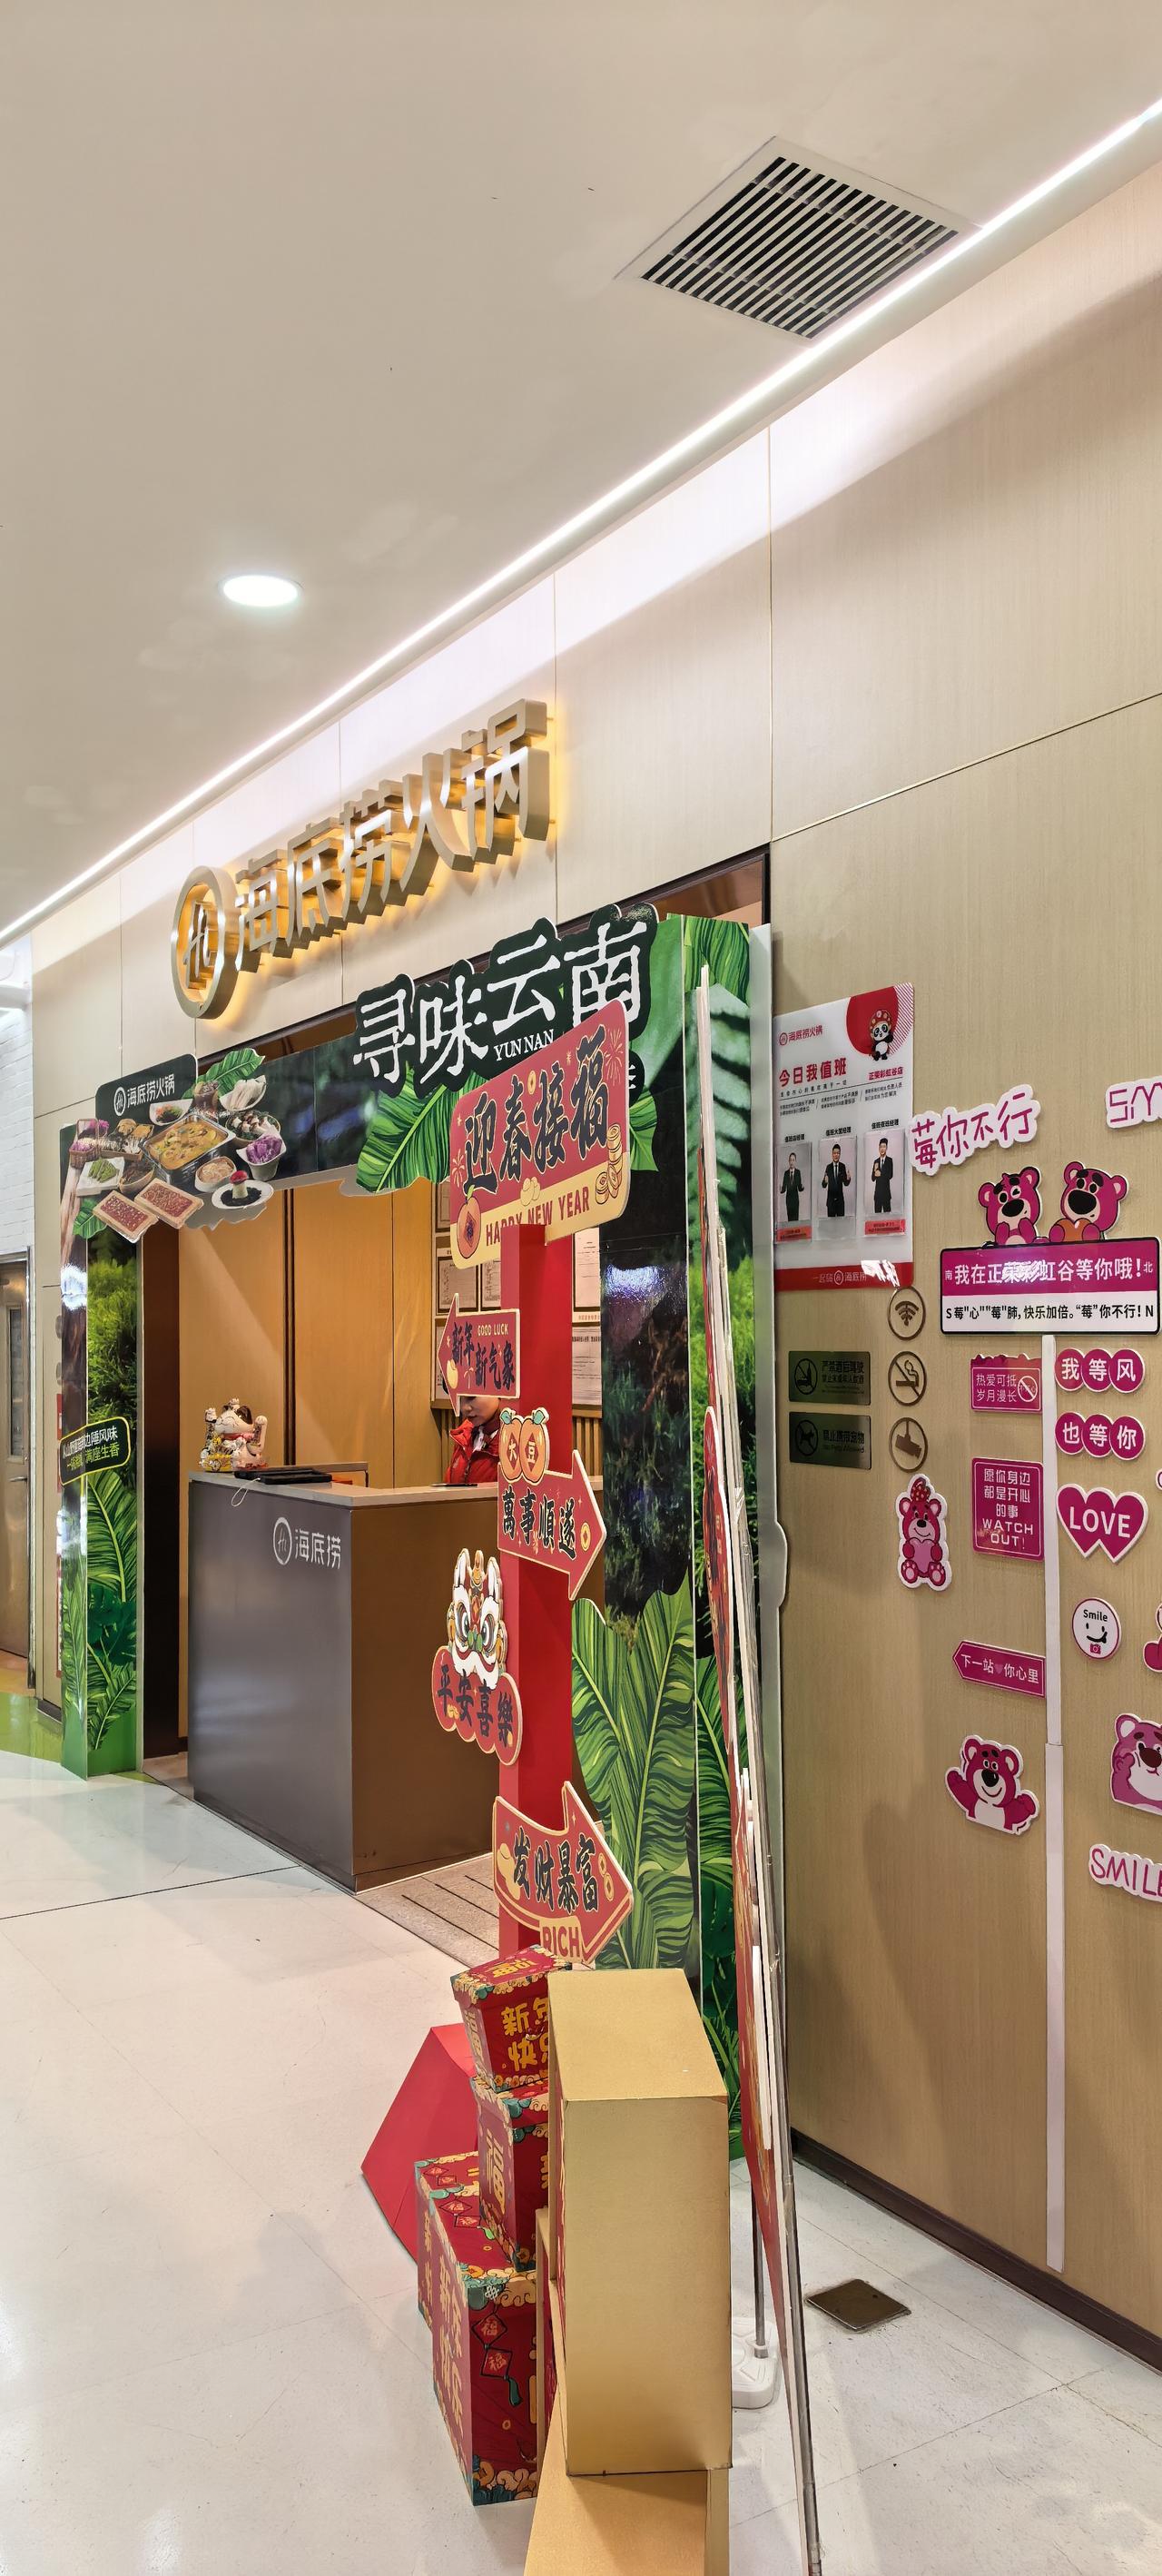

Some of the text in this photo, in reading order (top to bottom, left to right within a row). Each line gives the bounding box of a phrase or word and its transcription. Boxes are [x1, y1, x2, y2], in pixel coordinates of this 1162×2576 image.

[235, 698, 549, 972] 海底捞火锅
[353, 922, 647, 1084] 寻味云南
[788, 1025, 822, 1041] 海底捞火锅
[779, 1057, 847, 1087] 今日我值班
[127, 1074, 175, 1108] 海底捞火锅
[464, 1024, 609, 1195] 迎春接福
[911, 1092, 1032, 1169] 莓你不行
[527, 1201, 553, 1226] NEW
[557, 1186, 590, 1221] YEAR
[945, 1270, 953, 1280] 南
[1143, 1261, 1153, 1273] 北
[478, 1323, 508, 1336] GOOD LUCK
[475, 1340, 515, 1391] 新气象
[976, 1374, 1017, 1387] 热爱可抵
[1061, 1357, 1136, 1381] 我等风
[976, 1389, 1017, 1403] 岁月漫长
[1062, 1422, 1137, 1449] 也等你
[984, 1468, 1030, 1485] 愿你身边
[984, 1485, 1031, 1504] 都是开心
[501, 1485, 576, 1561] 萬事順遂
[996, 1504, 1019, 1518] 的事
[1069, 1506, 1131, 1538] LOVE
[982, 1518, 1034, 1535] WATCH
[990, 1533, 1026, 1549] OUT!
[295, 1528, 341, 1569] 海底捞
[1083, 1609, 1108, 1623] Smile
[960, 1653, 1039, 1684] 下一站 你心里
[437, 1663, 514, 1750] 平安喜樂
[513, 1827, 599, 1914] 发财暴富
[543, 1926, 580, 1957] RICH
[481, 2317, 498, 2337] 福
